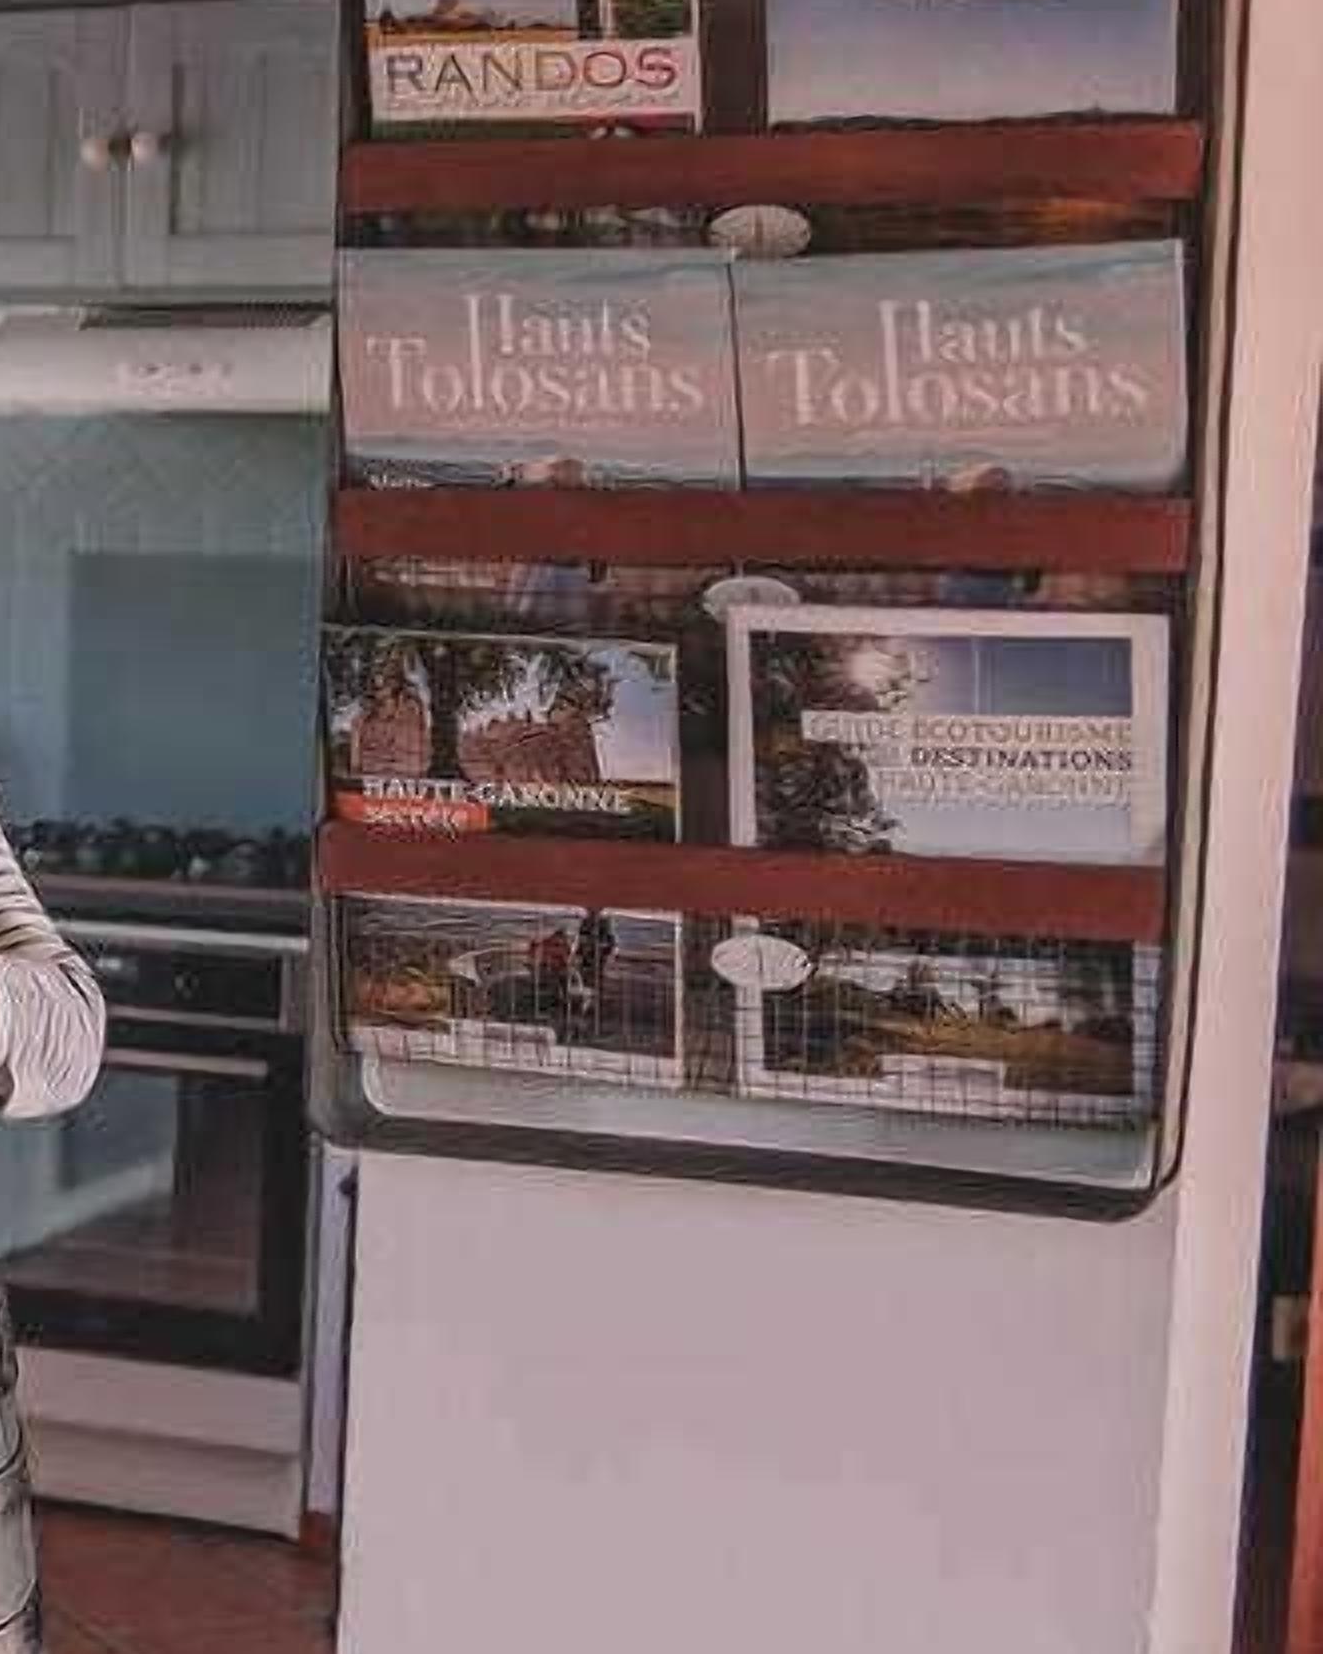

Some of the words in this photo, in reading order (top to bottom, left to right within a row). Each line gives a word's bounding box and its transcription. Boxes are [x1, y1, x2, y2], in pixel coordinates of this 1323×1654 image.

[384, 48, 681, 93] RANDOS
[463, 293, 652, 357] Hauts
[878, 298, 1091, 361] Hauts
[365, 332, 705, 413] Tolosans
[757, 347, 1149, 427] Tolosans
[910, 746, 1133, 771] DESTINATIONS
[362, 777, 632, 813] HAUTE-GARONNE
